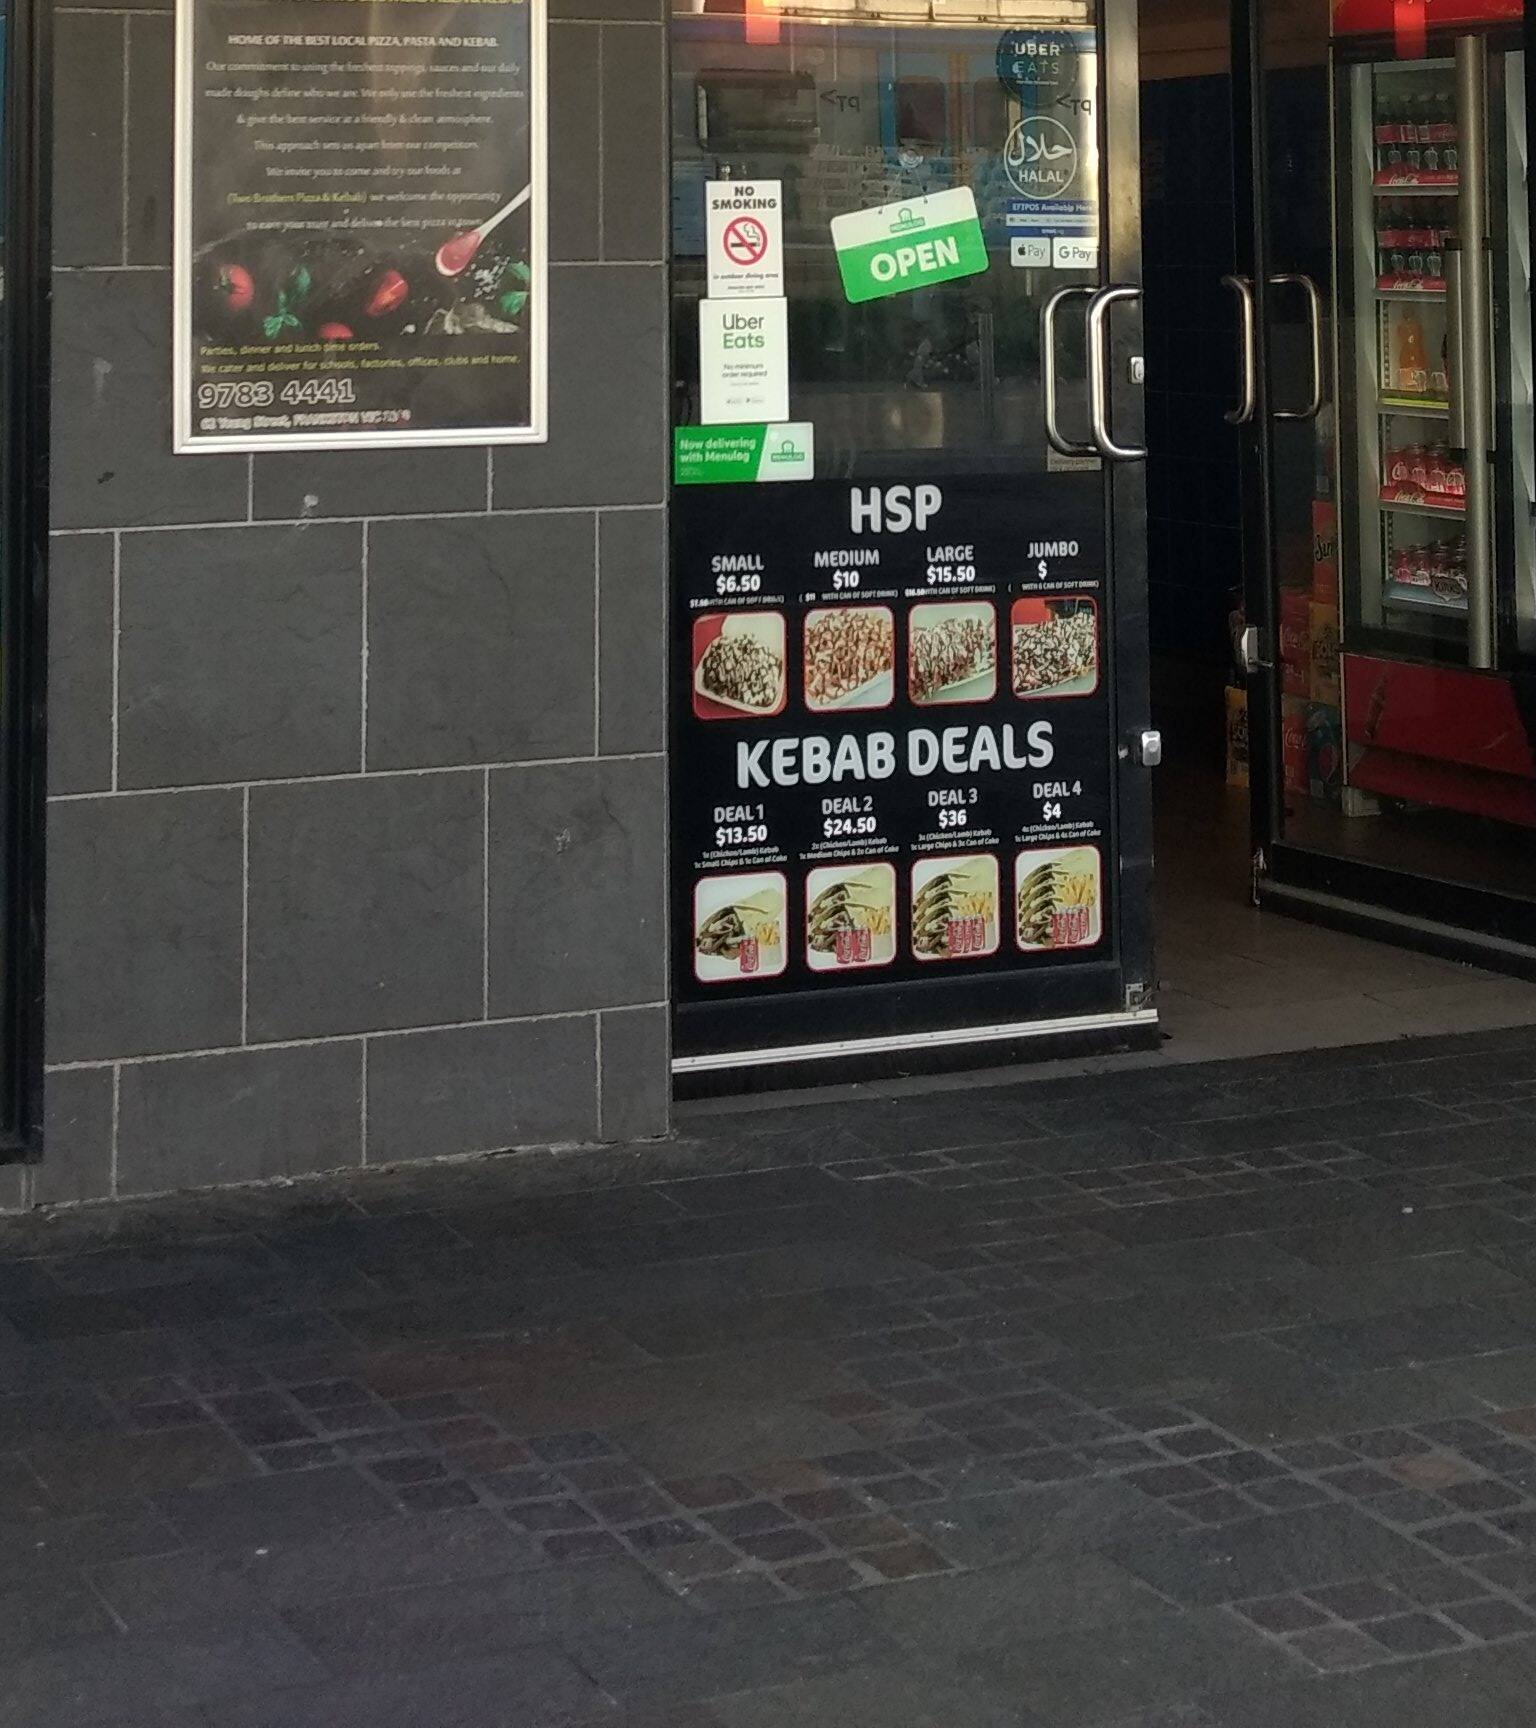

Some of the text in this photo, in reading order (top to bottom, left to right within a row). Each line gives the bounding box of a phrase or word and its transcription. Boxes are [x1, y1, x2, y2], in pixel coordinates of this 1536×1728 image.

[1015, 42, 1061, 56] UBER
[1016, 60, 1060, 75] EATS
[1018, 170, 1064, 183] HALAL
[734, 186, 755, 196] NO
[712, 198, 778, 210] SMOKING
[870, 236, 960, 282] OPEN
[1027, 244, 1045, 260] Pay
[1072, 246, 1091, 261] Pay
[722, 313, 765, 330] Uber
[722, 332, 765, 349] Eats
[198, 378, 357, 409] 9783 4441
[705, 436, 756, 450] delivering
[680, 451, 703, 462] with
[849, 483, 943, 536] HSP
[814, 549, 880, 568] MEDIUM
[926, 545, 974, 562] LARGE
[1027, 541, 1079, 559] JUMBO
[711, 554, 764, 572] SMALL
[716, 574, 761, 595] $6.50
[832, 569, 859, 590] $10
[926, 565, 976, 585] $15.50
[736, 720, 1055, 790] KEBAB DEALS
[928, 787, 978, 807] DEAL 3
[1032, 780, 1082, 799] DEAL 4
[714, 803, 764, 823] DEAL 1
[822, 795, 873, 815] DEAL 2
[1042, 800, 1062, 822] $4
[823, 816, 877, 839] $24.50
[938, 808, 967, 830] $36
[716, 824, 768, 847] $13.50
